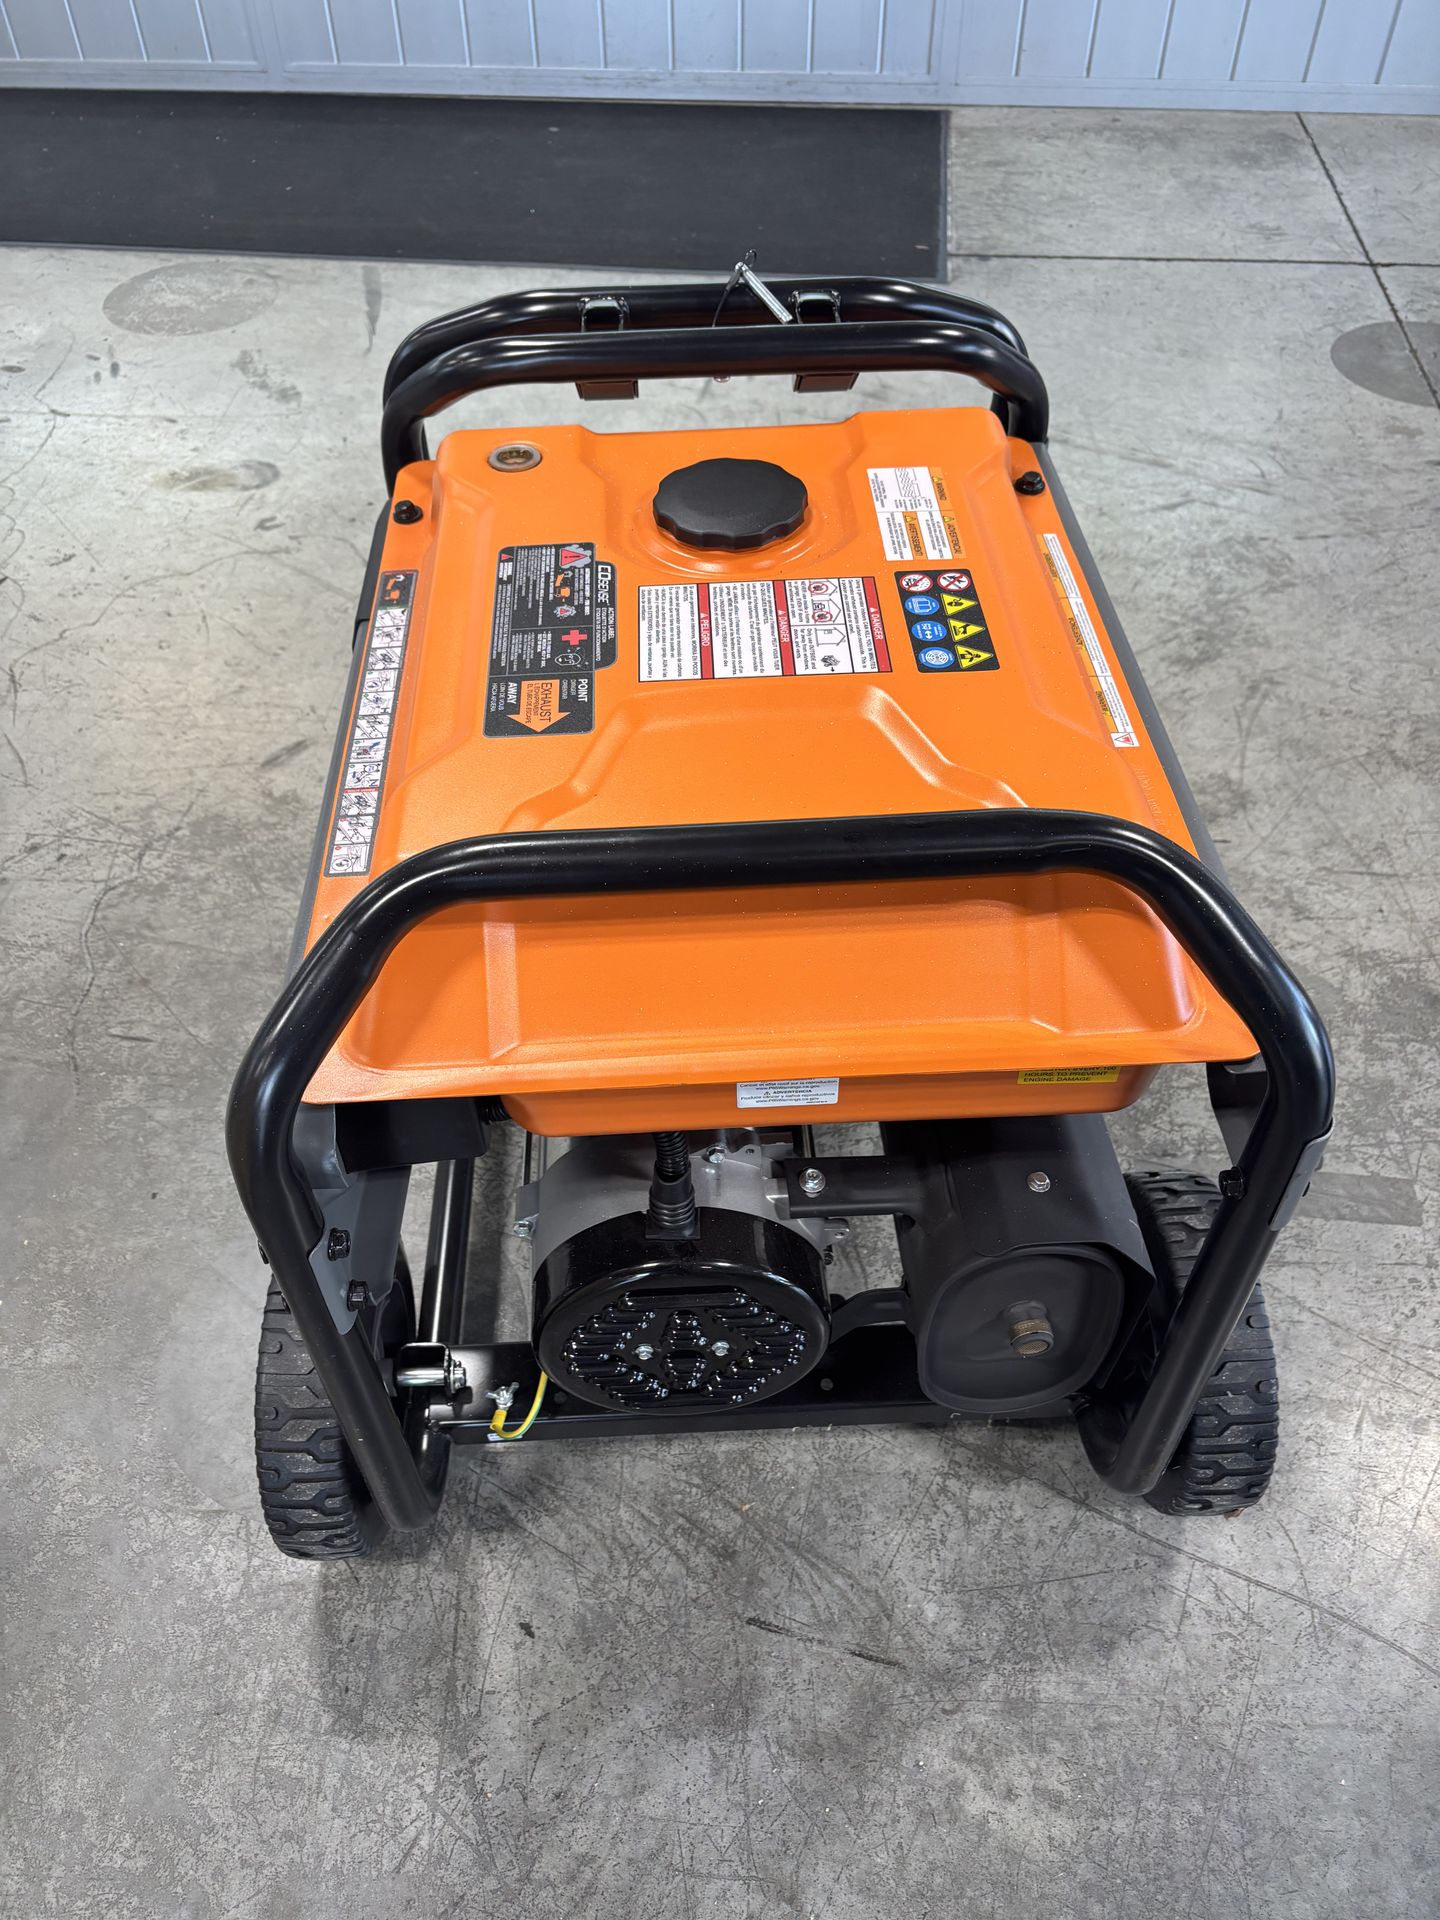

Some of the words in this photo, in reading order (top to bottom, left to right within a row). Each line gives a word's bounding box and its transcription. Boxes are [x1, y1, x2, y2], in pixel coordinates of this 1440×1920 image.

[701, 619, 710, 647] PELIGRO
[778, 616, 790, 643] DANGER
[871, 613, 883, 640] DANGER
[506, 682, 518, 704] AWAY
[539, 682, 553, 723] EXHAUST
[578, 679, 588, 702] POINT
